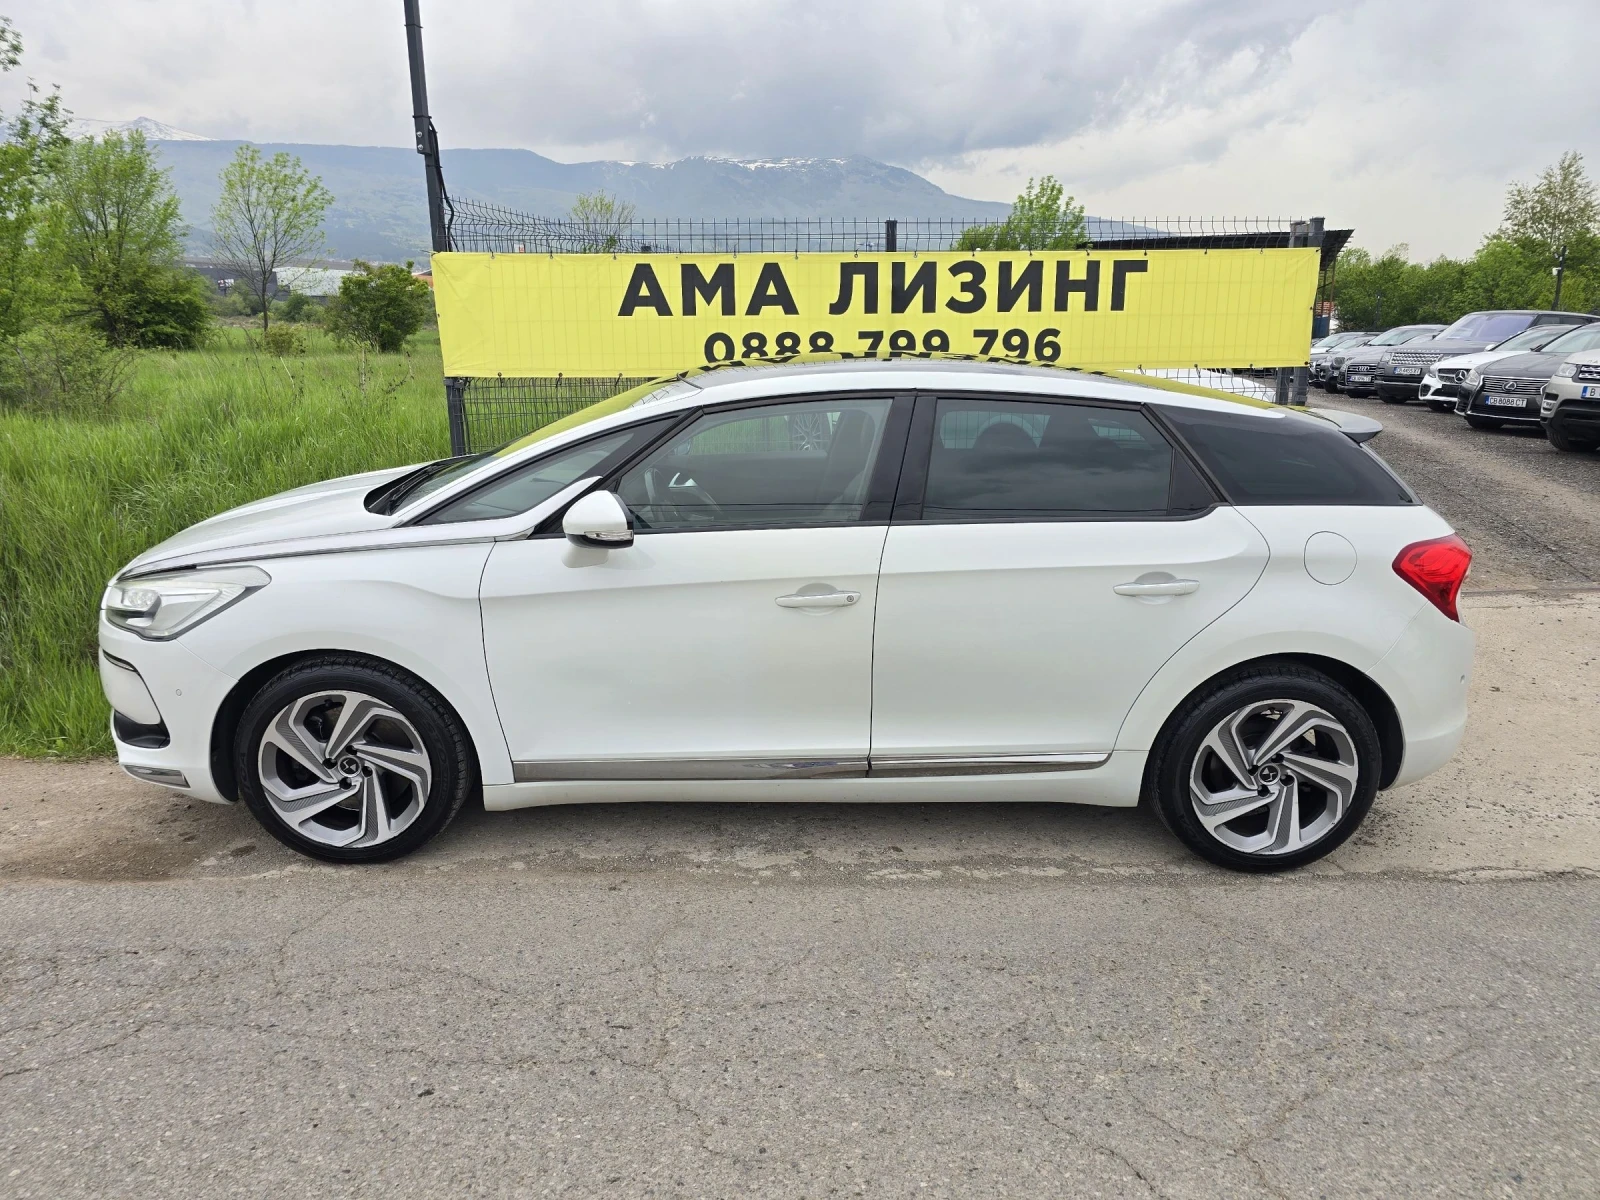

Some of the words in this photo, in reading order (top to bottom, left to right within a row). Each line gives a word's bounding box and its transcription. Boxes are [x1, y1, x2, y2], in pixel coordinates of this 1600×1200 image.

[617, 262, 799, 316] АМА
[828, 259, 1148, 315] ЛИЗИНГ
[704, 331, 834, 363] 0888
[858, 329, 950, 352] 799
[973, 328, 1061, 362] 796
